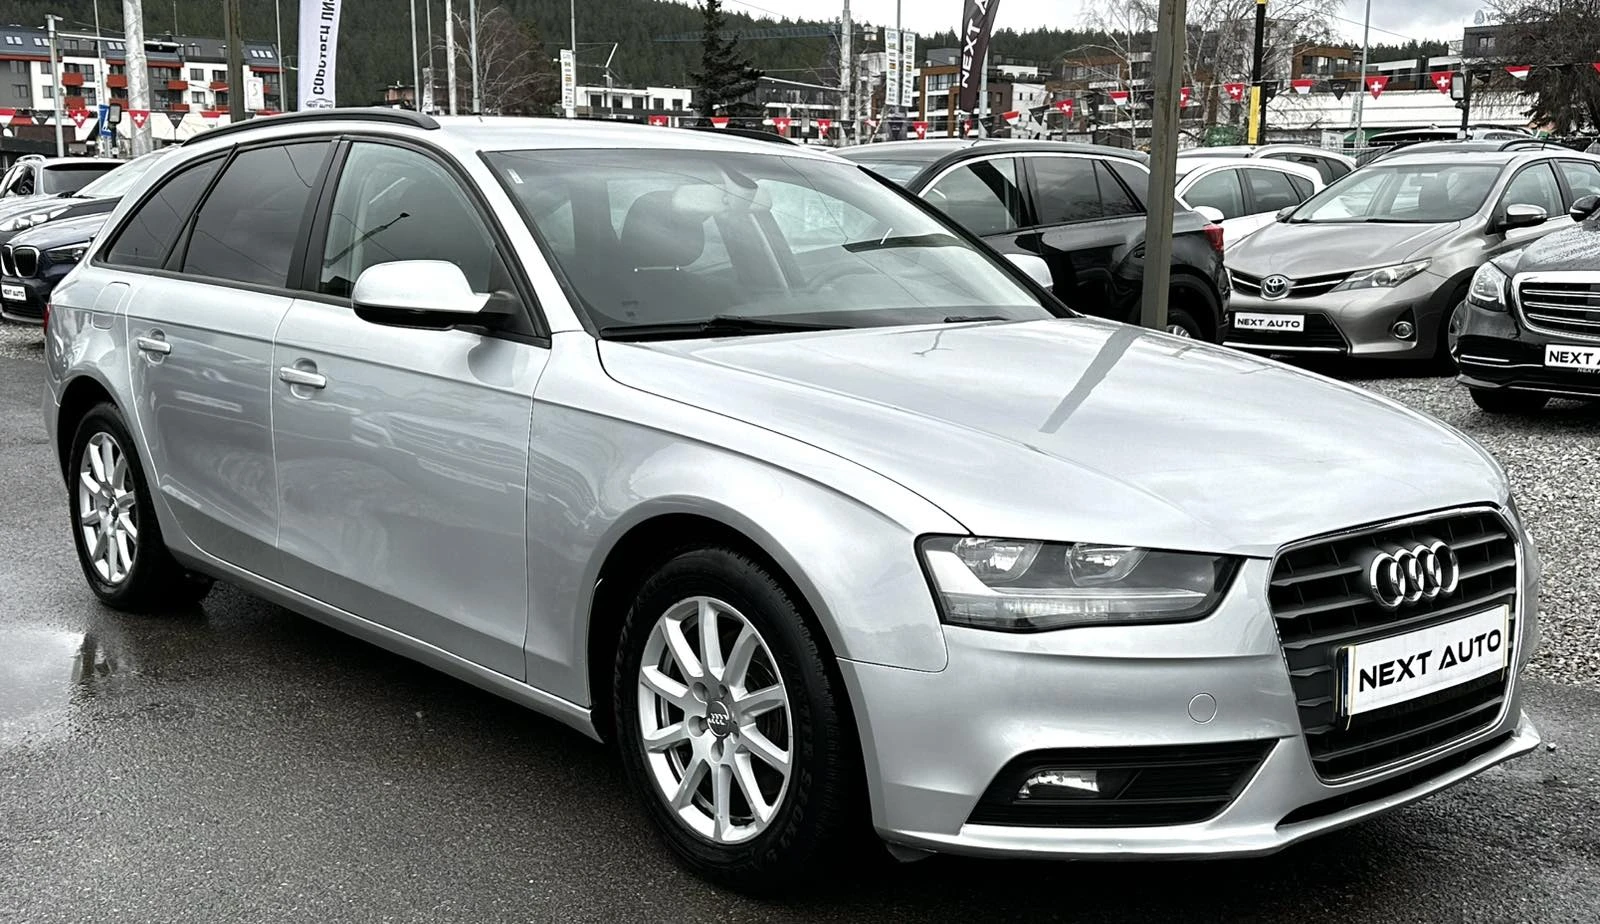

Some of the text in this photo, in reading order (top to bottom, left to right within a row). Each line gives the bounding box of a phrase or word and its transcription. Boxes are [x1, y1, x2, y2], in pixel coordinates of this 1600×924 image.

[961, 18, 981, 88] NEXT
[1237, 318, 1301, 328] NEXT AUTO
[1549, 350, 1594, 365] NEXT
[1359, 628, 1502, 692] NEXT AUTO
